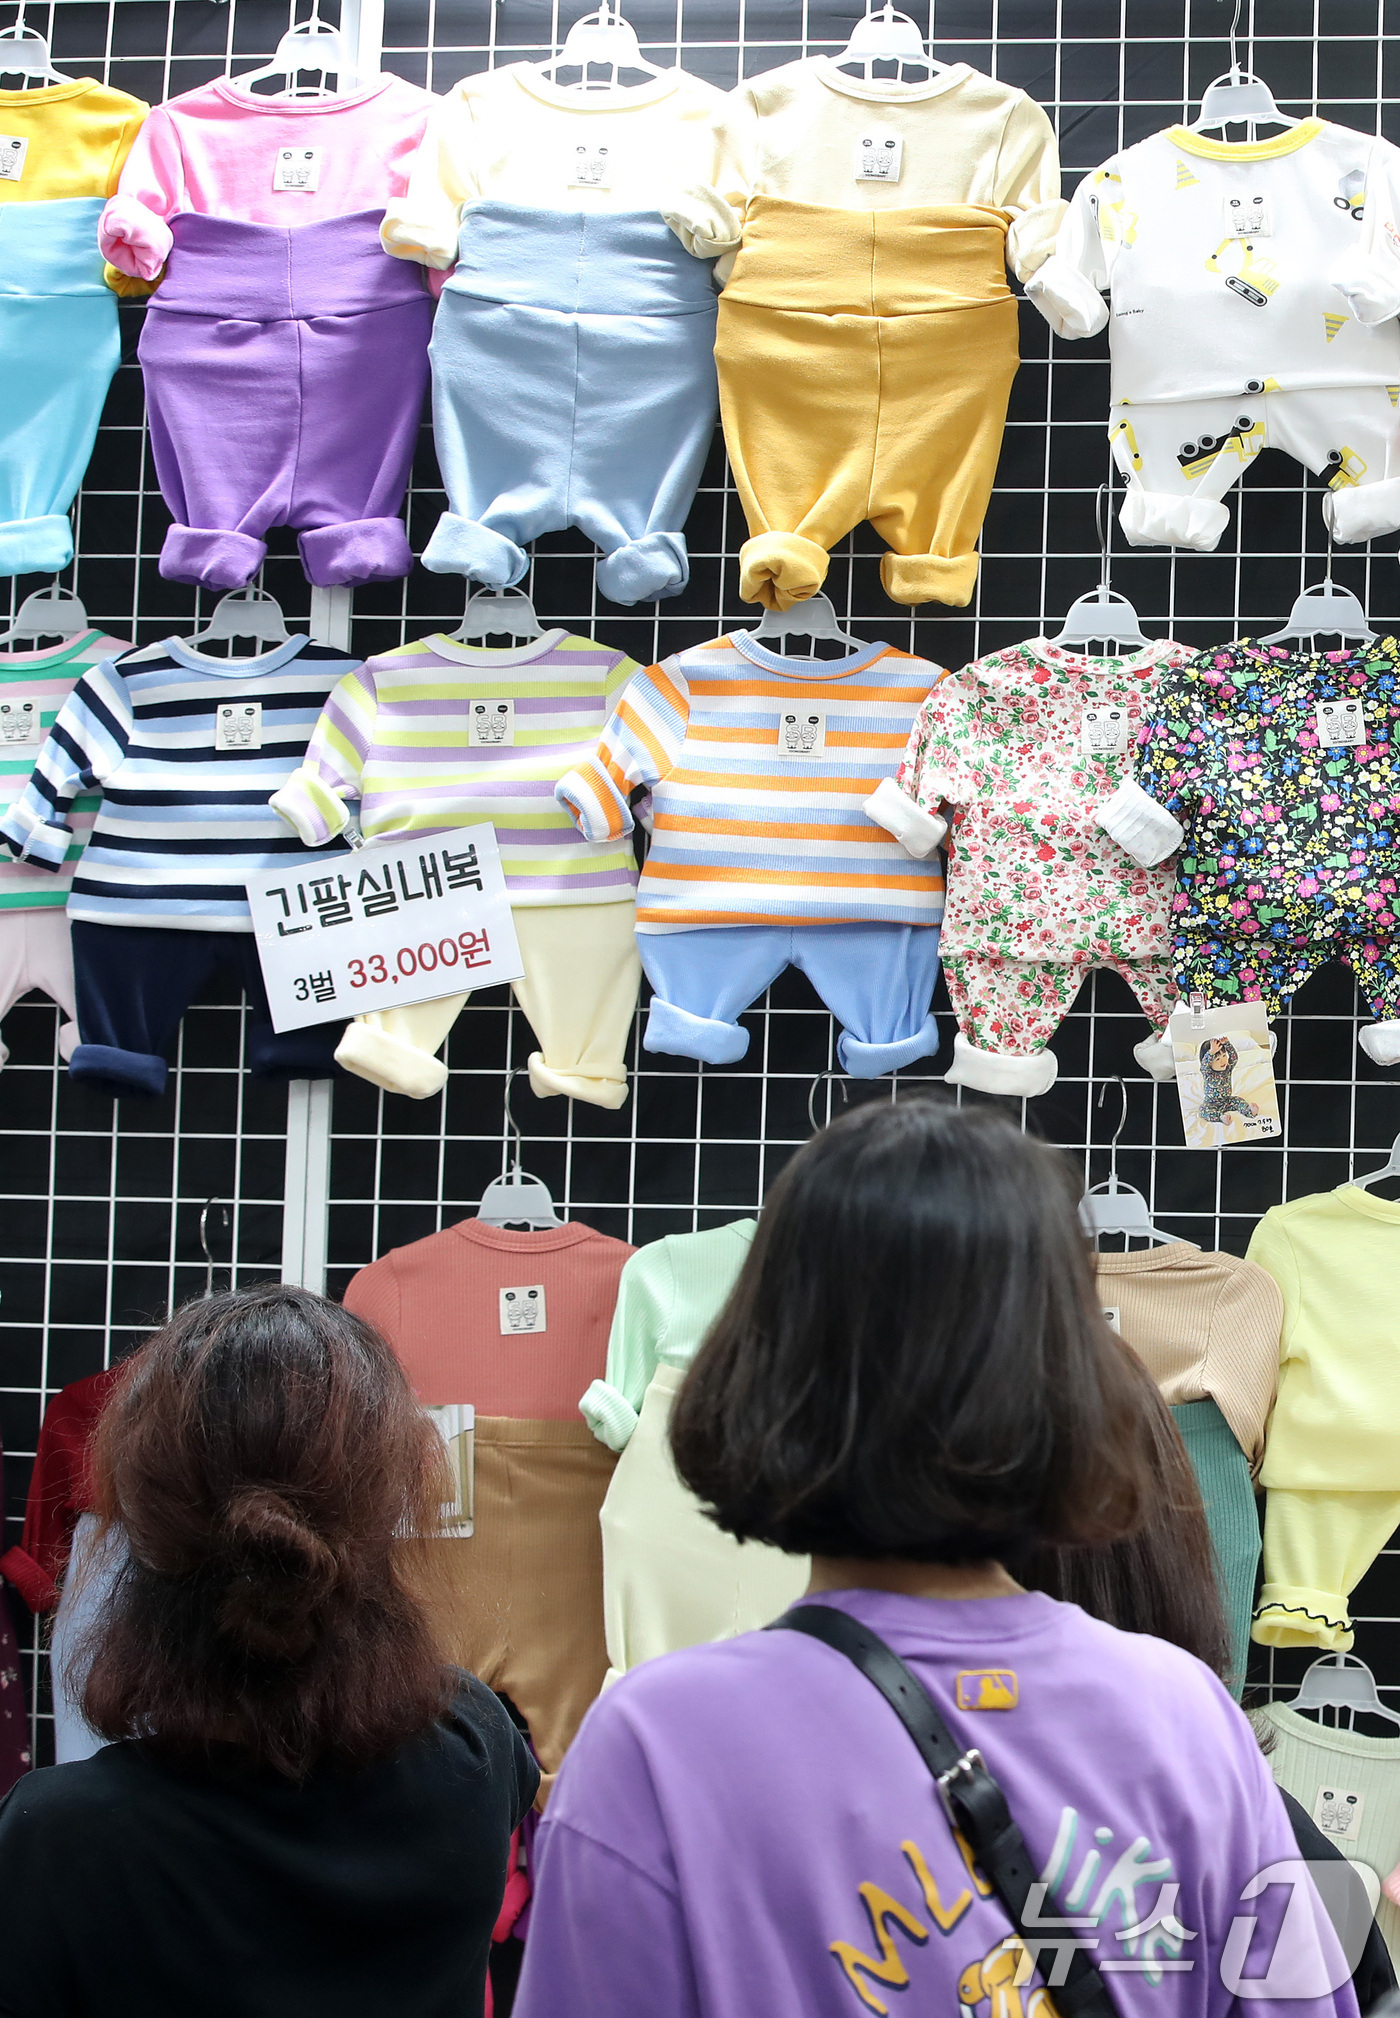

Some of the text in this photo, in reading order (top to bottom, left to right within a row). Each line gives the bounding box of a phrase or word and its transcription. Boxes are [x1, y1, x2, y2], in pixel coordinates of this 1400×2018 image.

[265, 843, 484, 937] 긴팔실내복
[293, 928, 492, 1003] 3벌 33,000원
[830, 1826, 994, 2017] ML
